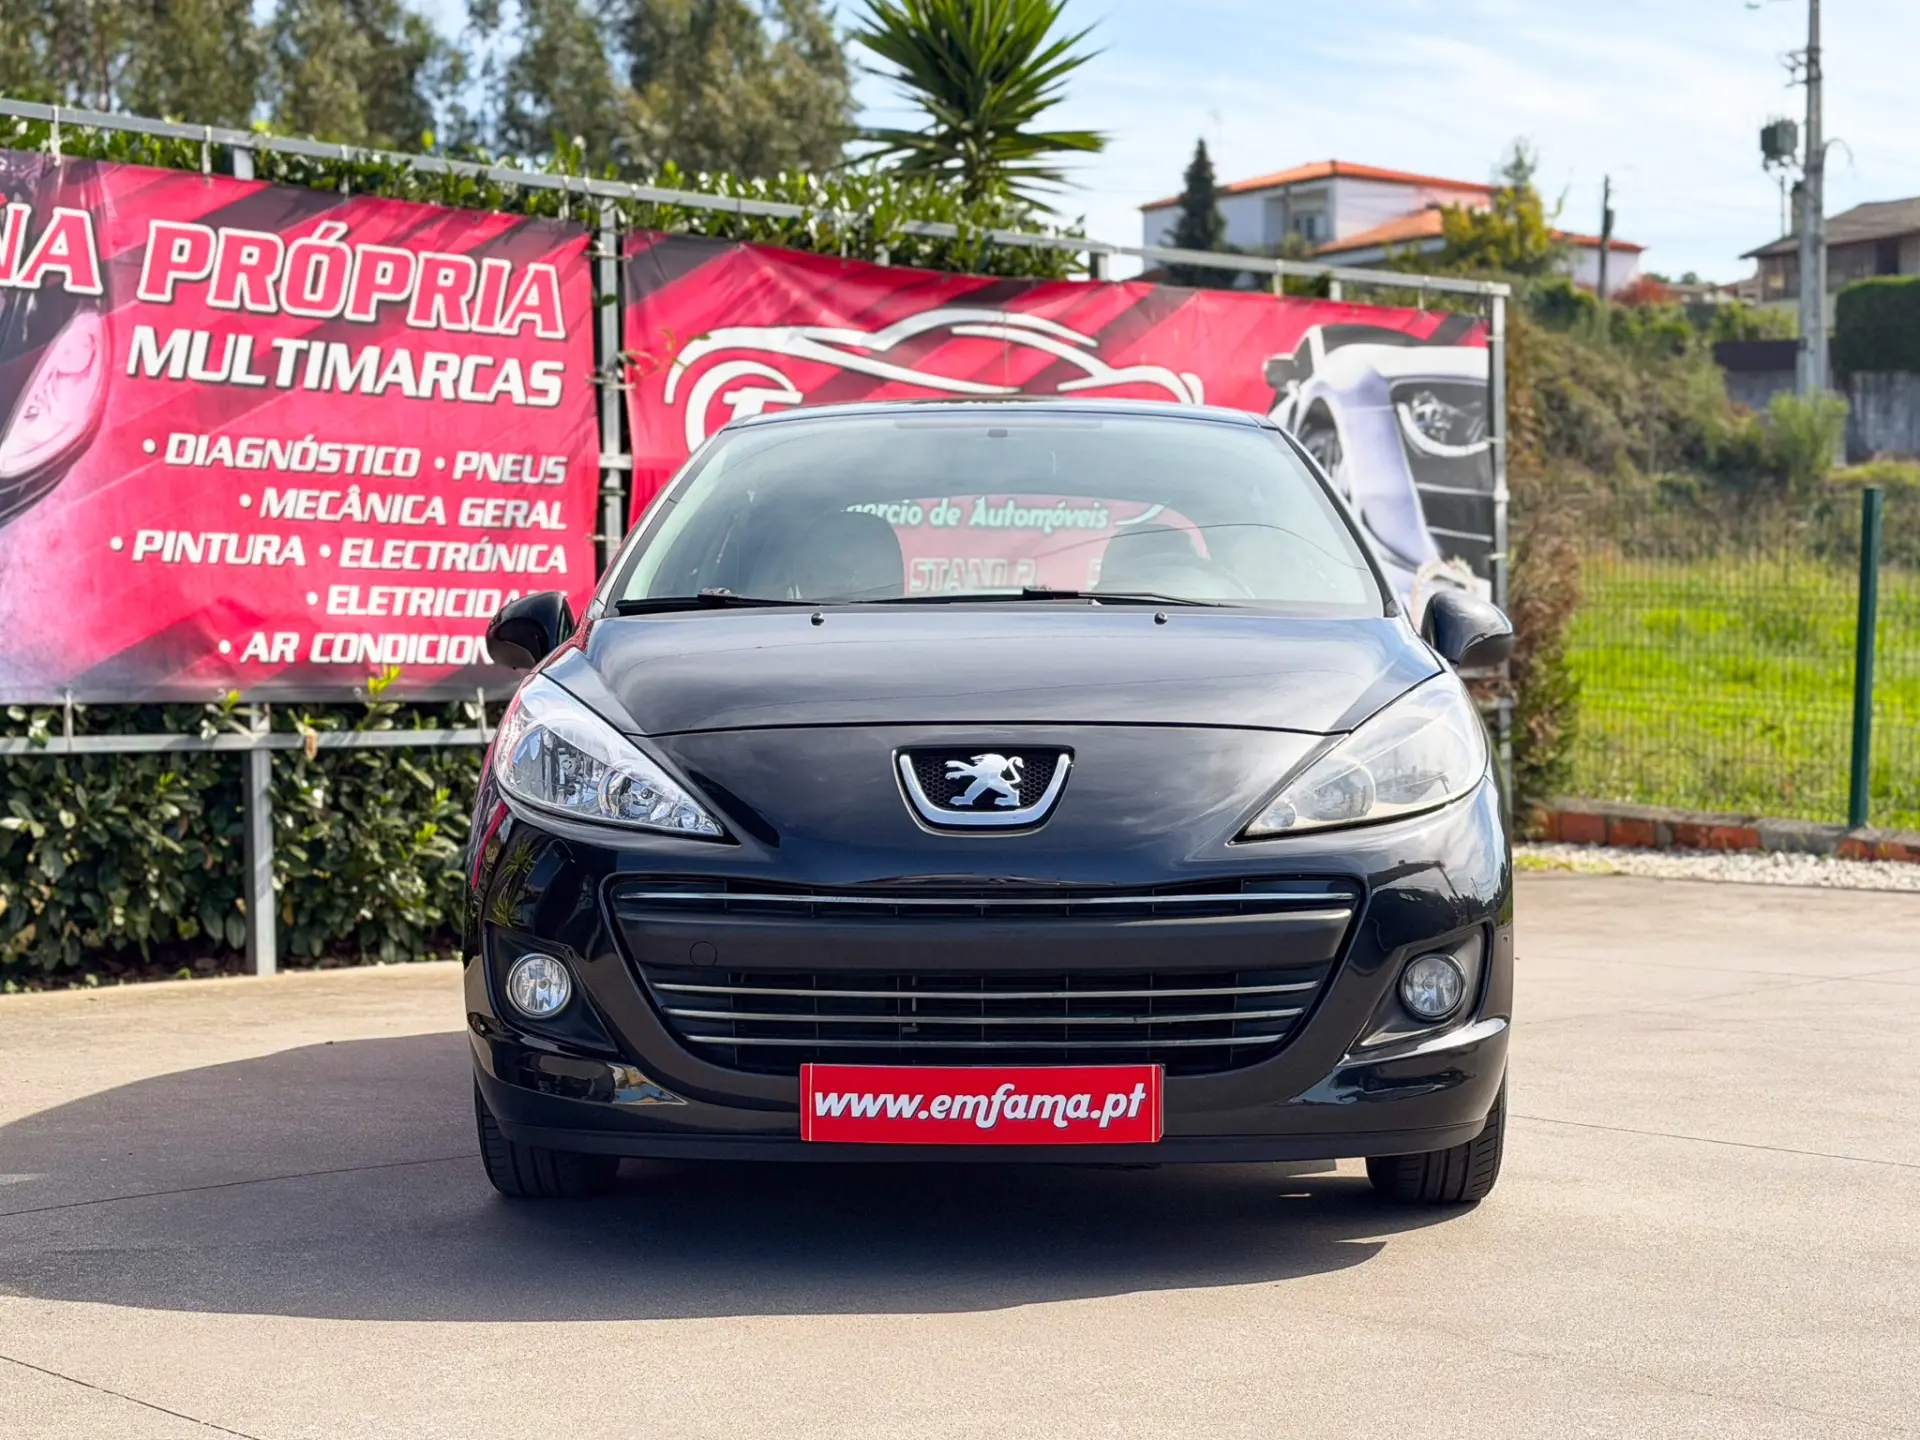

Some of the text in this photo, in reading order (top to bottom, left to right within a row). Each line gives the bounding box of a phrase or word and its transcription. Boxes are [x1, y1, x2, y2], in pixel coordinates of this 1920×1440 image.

[137, 219, 567, 339] PRÓPRIA
[126, 325, 566, 406] MULTIMARCAS
[164, 432, 568, 485] DIAGNÓSTICO PNEUS
[259, 485, 568, 530] MECÂNICA GERAL
[929, 498, 961, 526] de
[969, 496, 1109, 533] Automóveis
[132, 529, 568, 574] PINTURA ELECTRÓNICA
[326, 585, 568, 619] ELETRICID
[240, 631, 300, 663] AR
[814, 1083, 1146, 1129] www.emfama.pt
